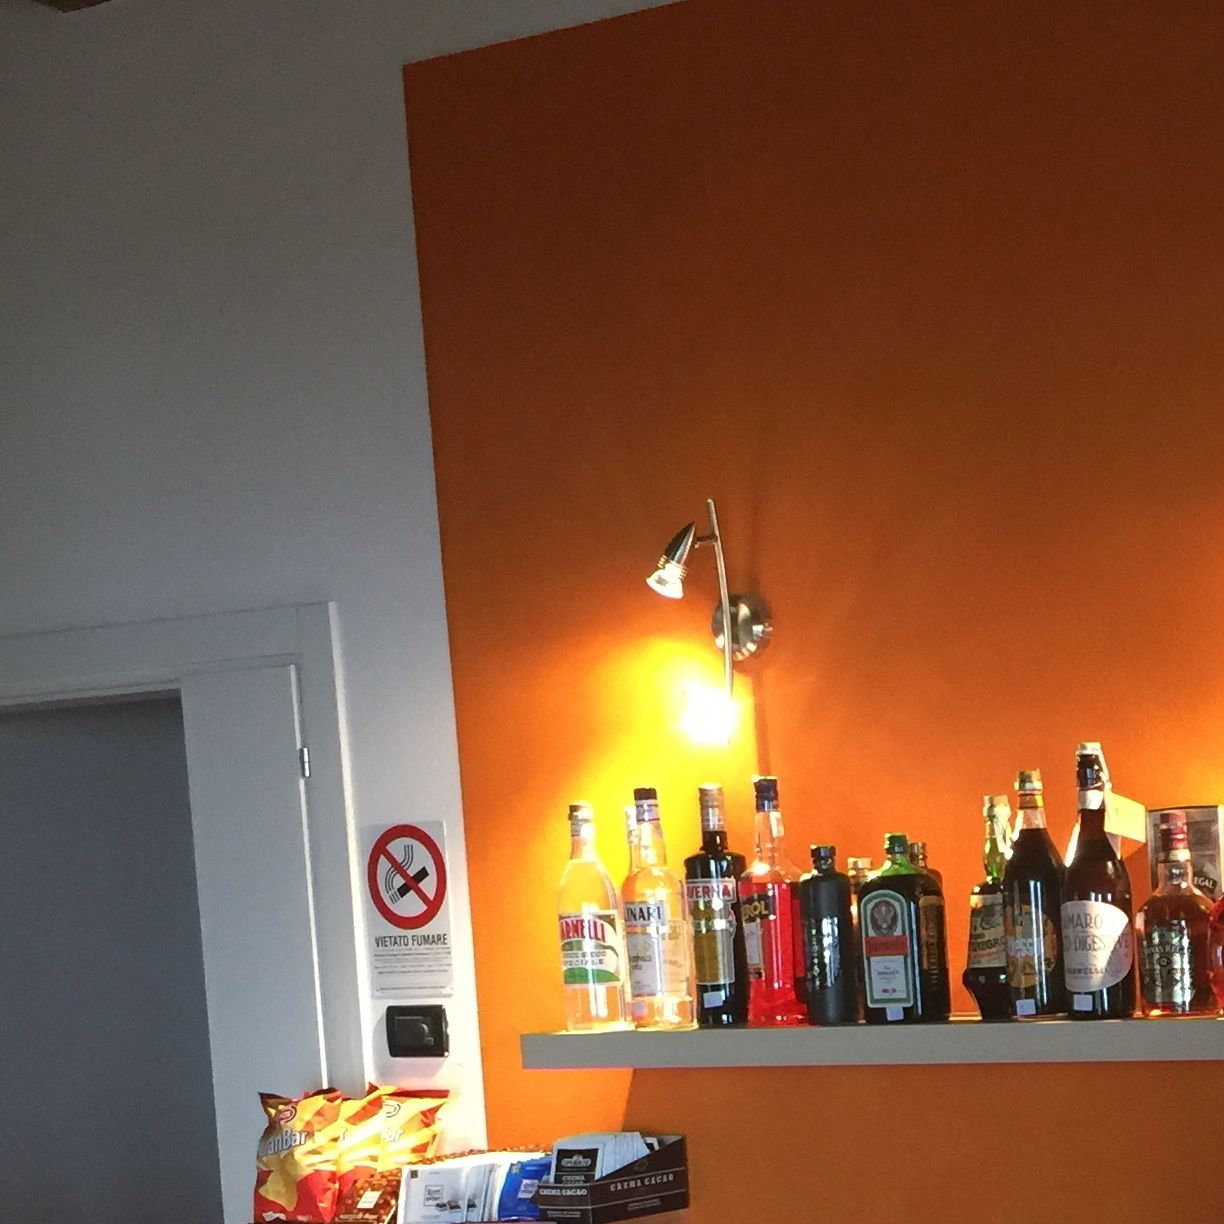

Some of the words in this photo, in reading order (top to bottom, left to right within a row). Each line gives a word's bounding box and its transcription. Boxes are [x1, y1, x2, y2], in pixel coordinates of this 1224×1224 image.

[687, 884, 735, 899] VERNA
[375, 934, 408, 948] VIETATO
[412, 933, 448, 947] FUMARE
[266, 1128, 308, 1153] anBar
[610, 1180, 642, 1192] CREMA
[645, 1173, 675, 1186] CACAO
[562, 1188, 588, 1197] CACAO
